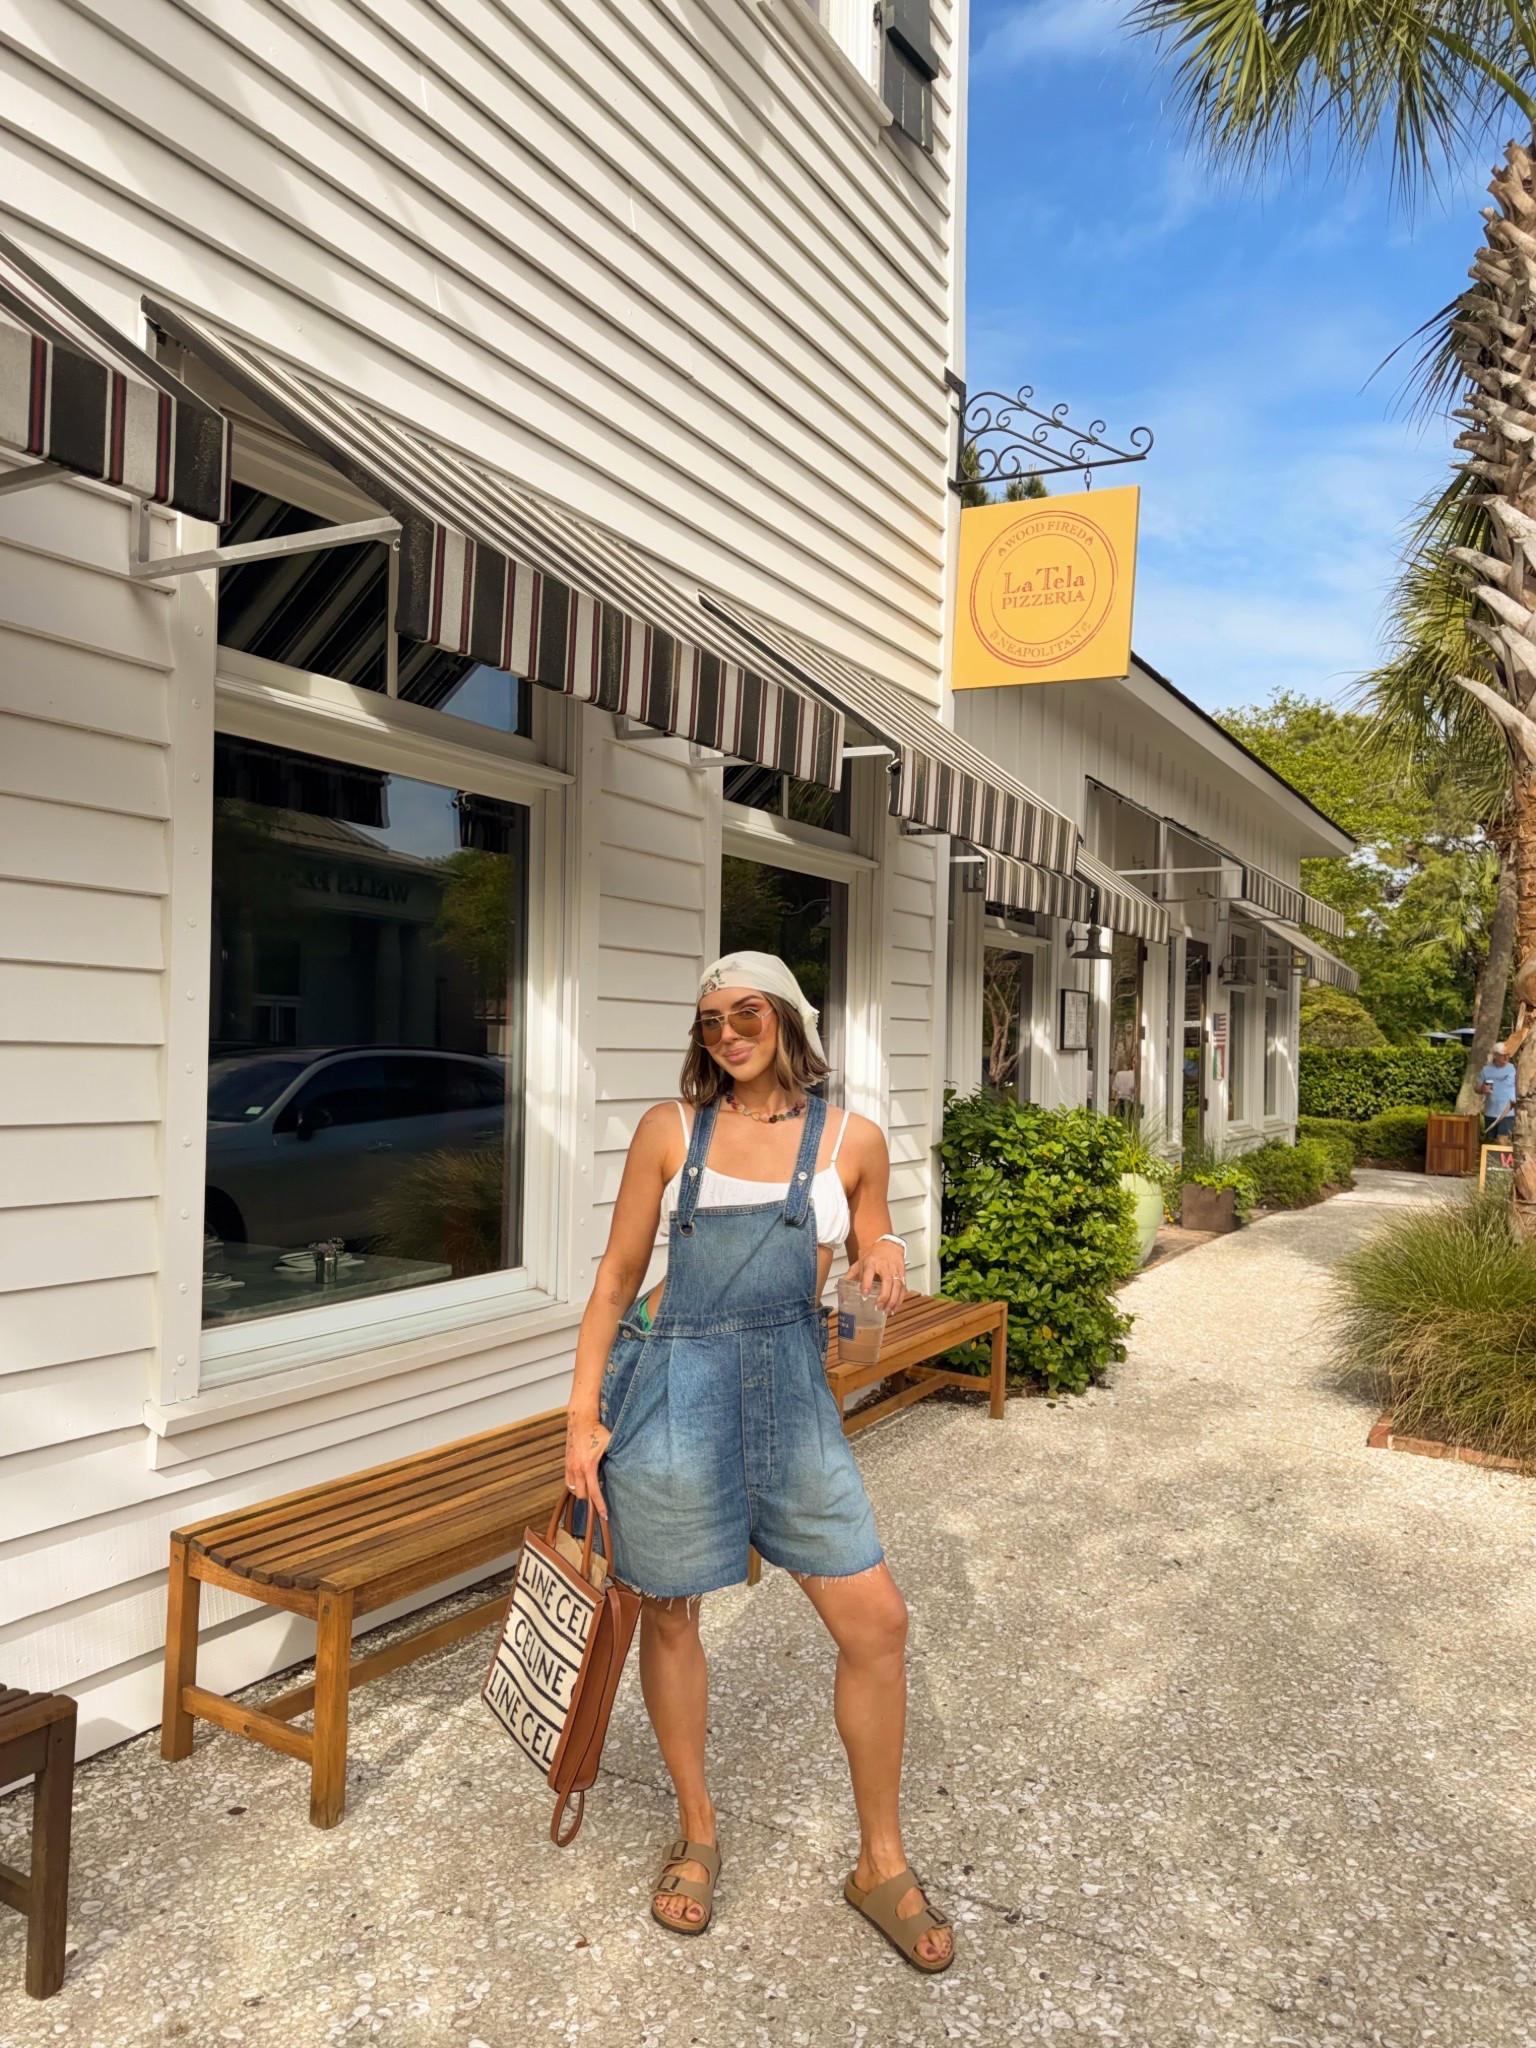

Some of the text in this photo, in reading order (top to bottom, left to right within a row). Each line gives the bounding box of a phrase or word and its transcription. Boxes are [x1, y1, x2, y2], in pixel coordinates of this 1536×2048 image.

[1005, 521, 1087, 549] WOOD FIRED
[1002, 565, 1085, 595] La Tela
[1001, 590, 1086, 610] PIZZERIA
[997, 630, 1082, 658] NEAPOLITAN
[514, 1619, 567, 1696] CELINE
